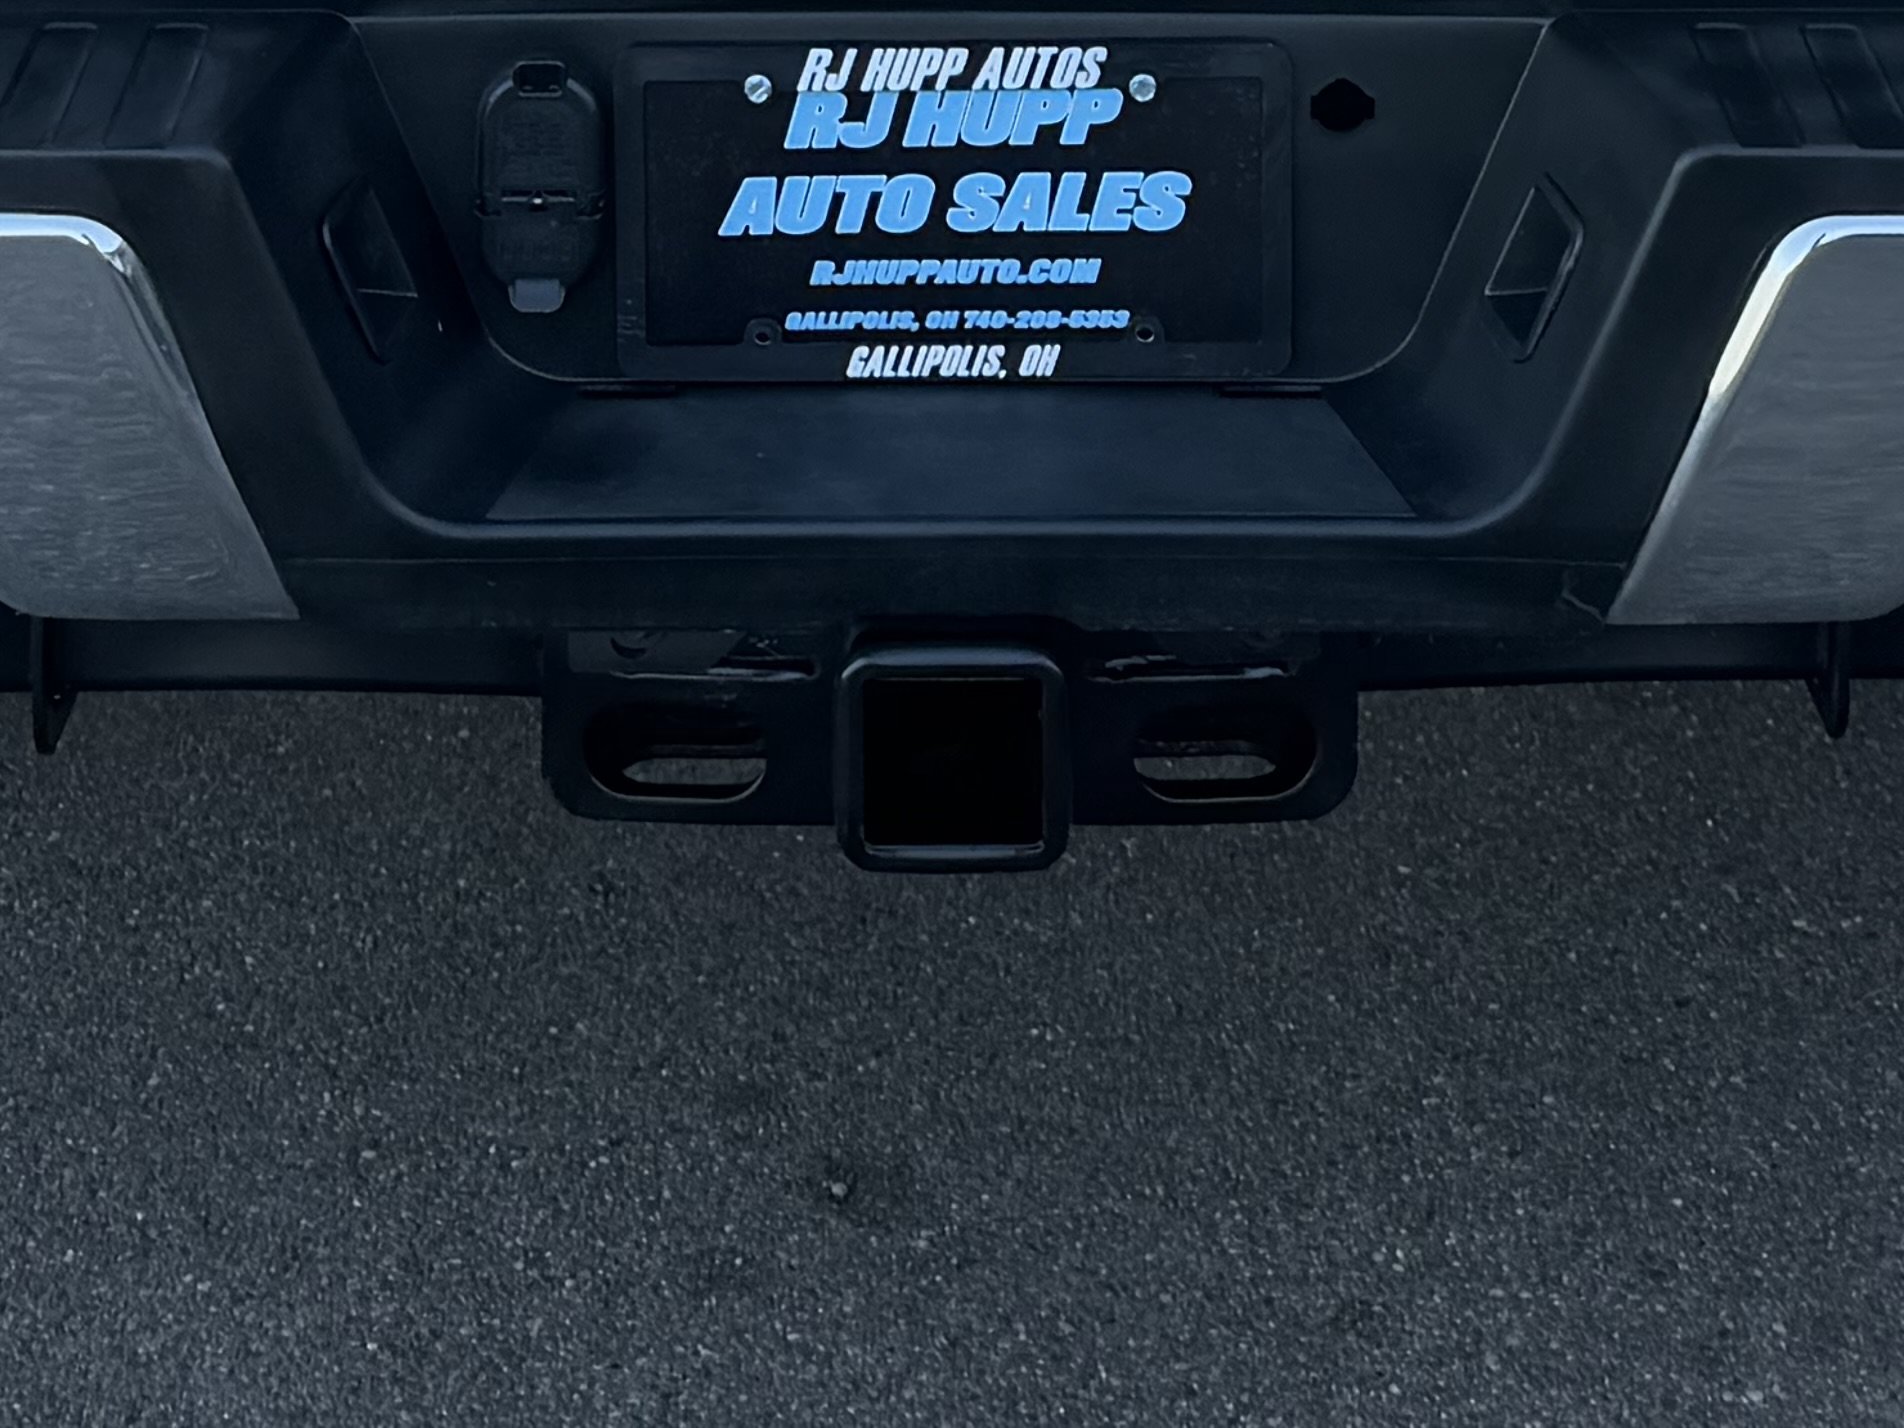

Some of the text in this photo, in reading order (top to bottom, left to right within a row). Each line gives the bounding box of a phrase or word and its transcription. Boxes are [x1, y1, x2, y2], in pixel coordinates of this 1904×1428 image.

[797, 47, 1108, 92] RJ HUPP AUTOS
[784, 88, 1124, 149] RJ HUPP
[717, 171, 1193, 236] AUTO SALES
[809, 258, 1102, 286] RJHUPPAUTO.COM
[784, 310, 920, 332] GALLIPOLIS,
[925, 310, 960, 329] OH
[846, 344, 1061, 379] GALLIPOLIS, OH
